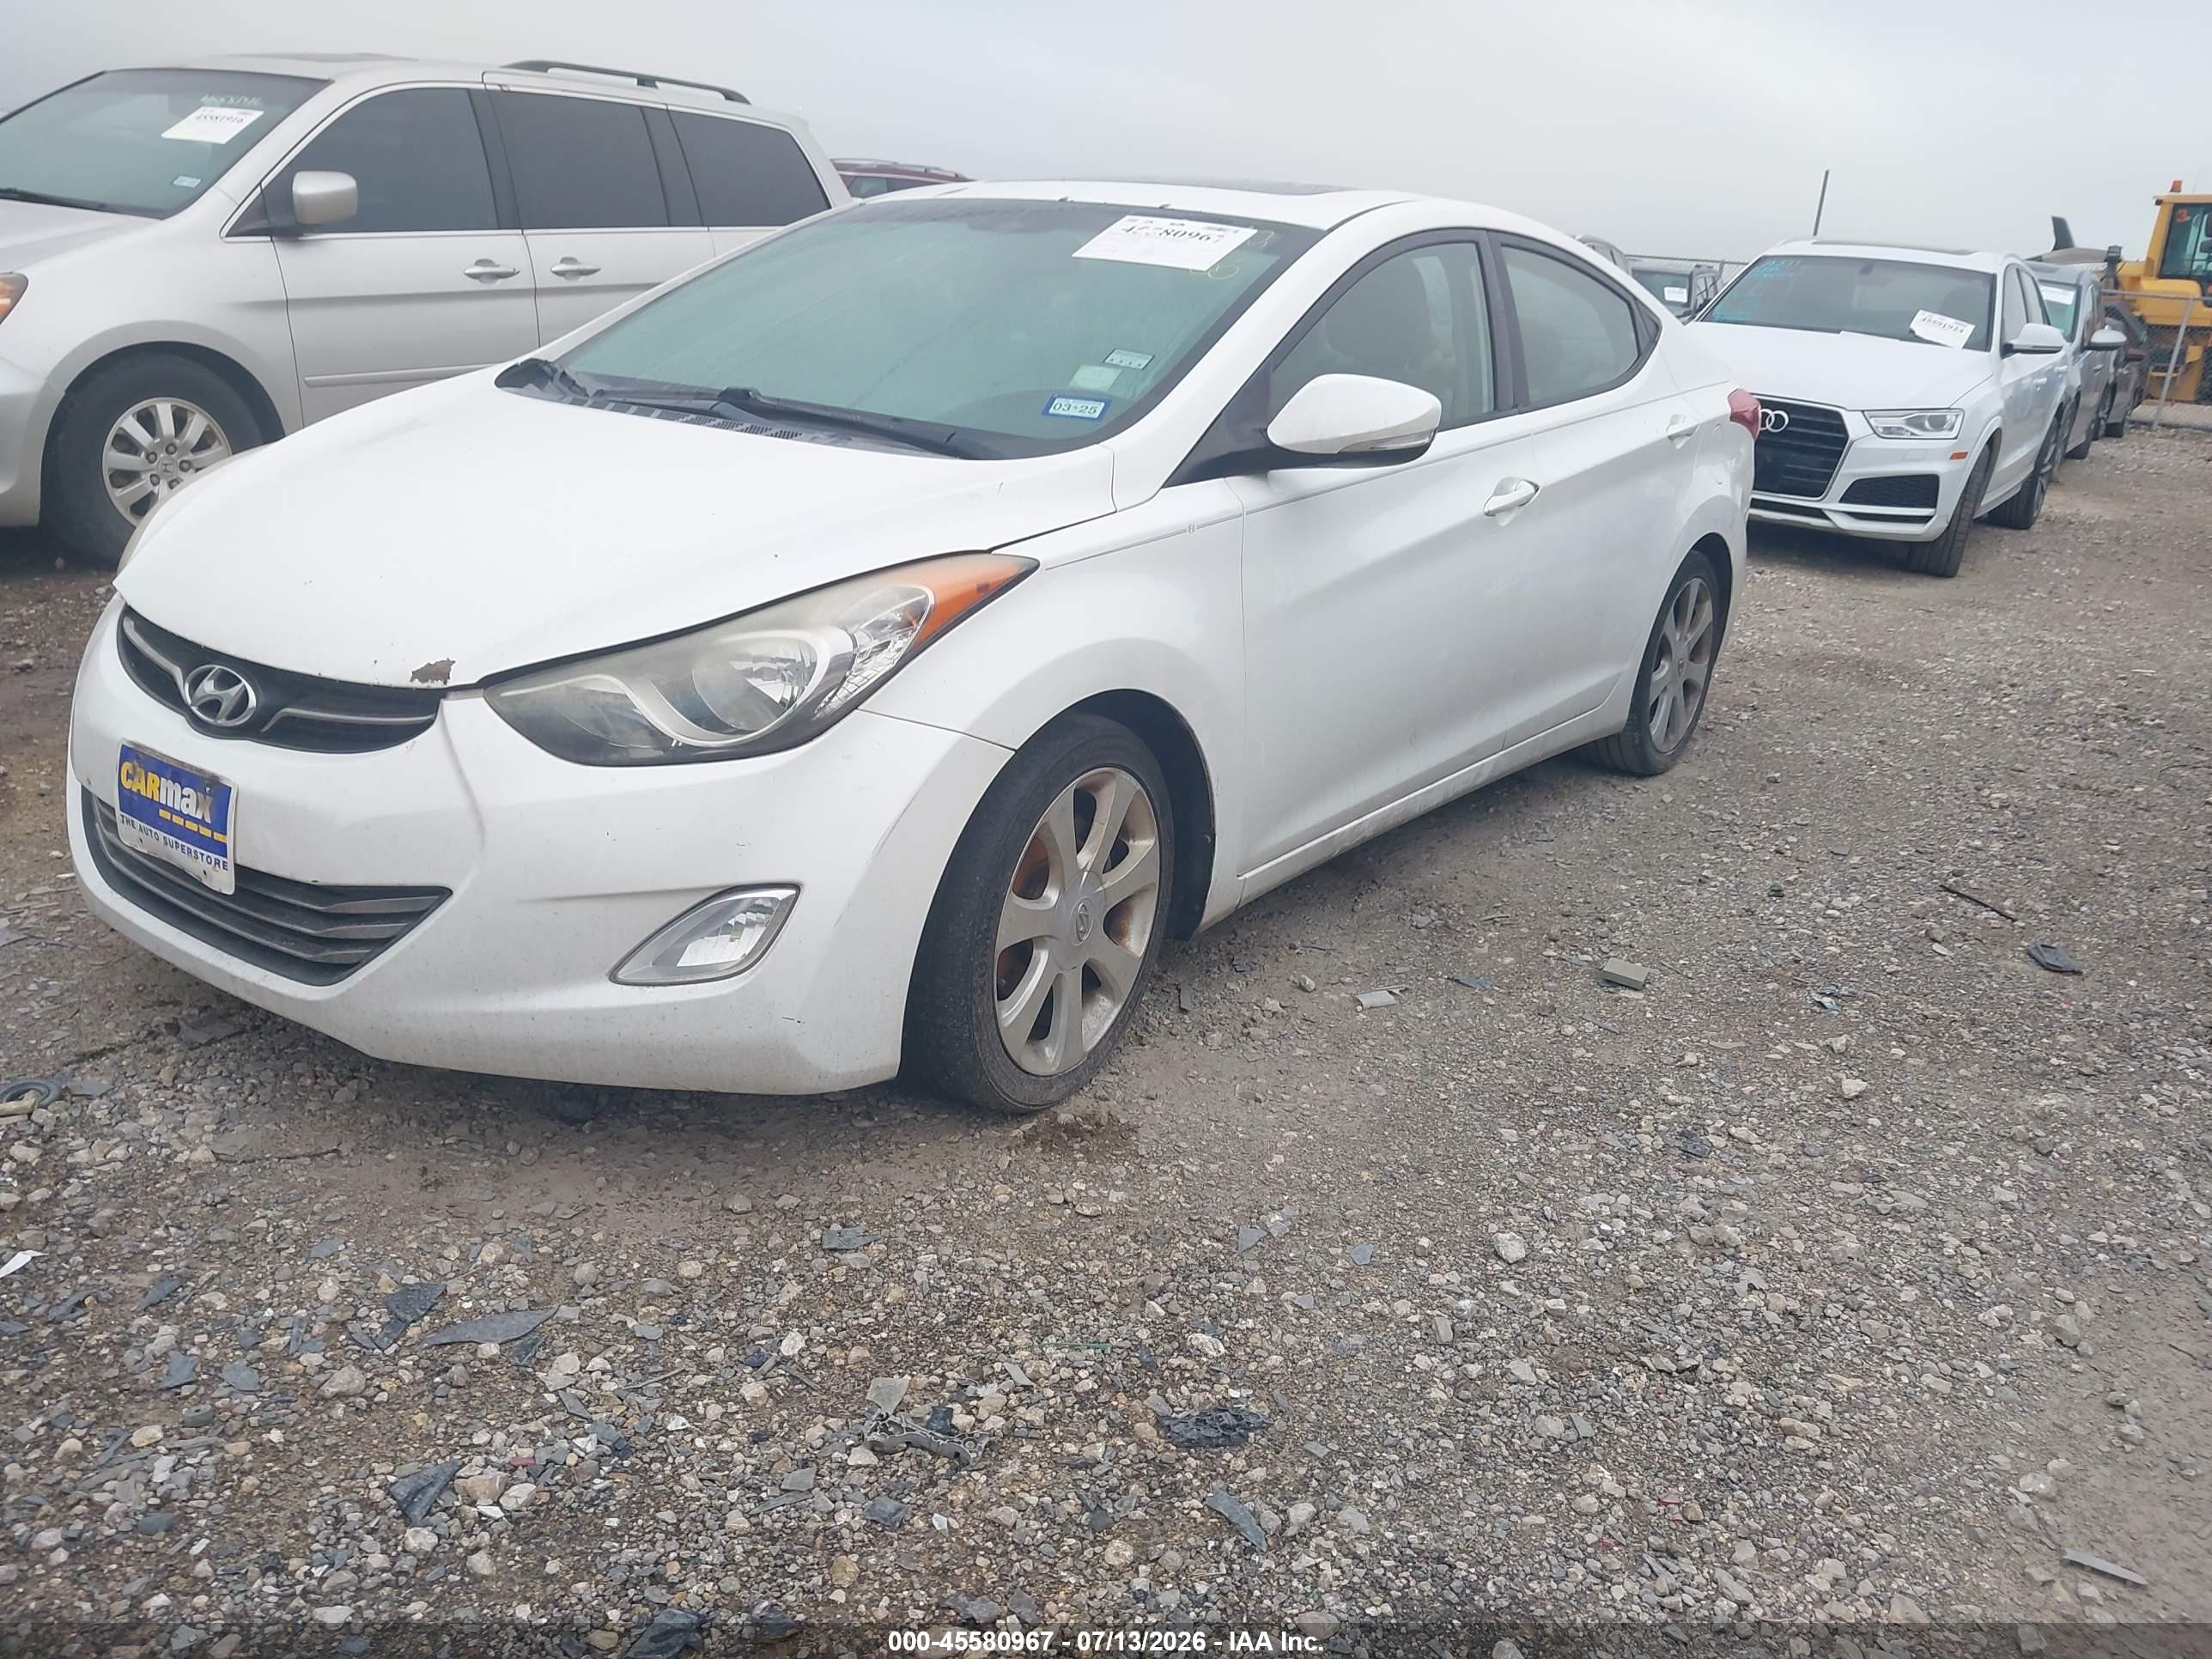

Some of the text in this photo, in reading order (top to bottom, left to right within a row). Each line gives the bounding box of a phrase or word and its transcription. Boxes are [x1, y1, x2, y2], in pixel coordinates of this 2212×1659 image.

[120, 814, 229, 872] THE AUTO SUPERSTORE
